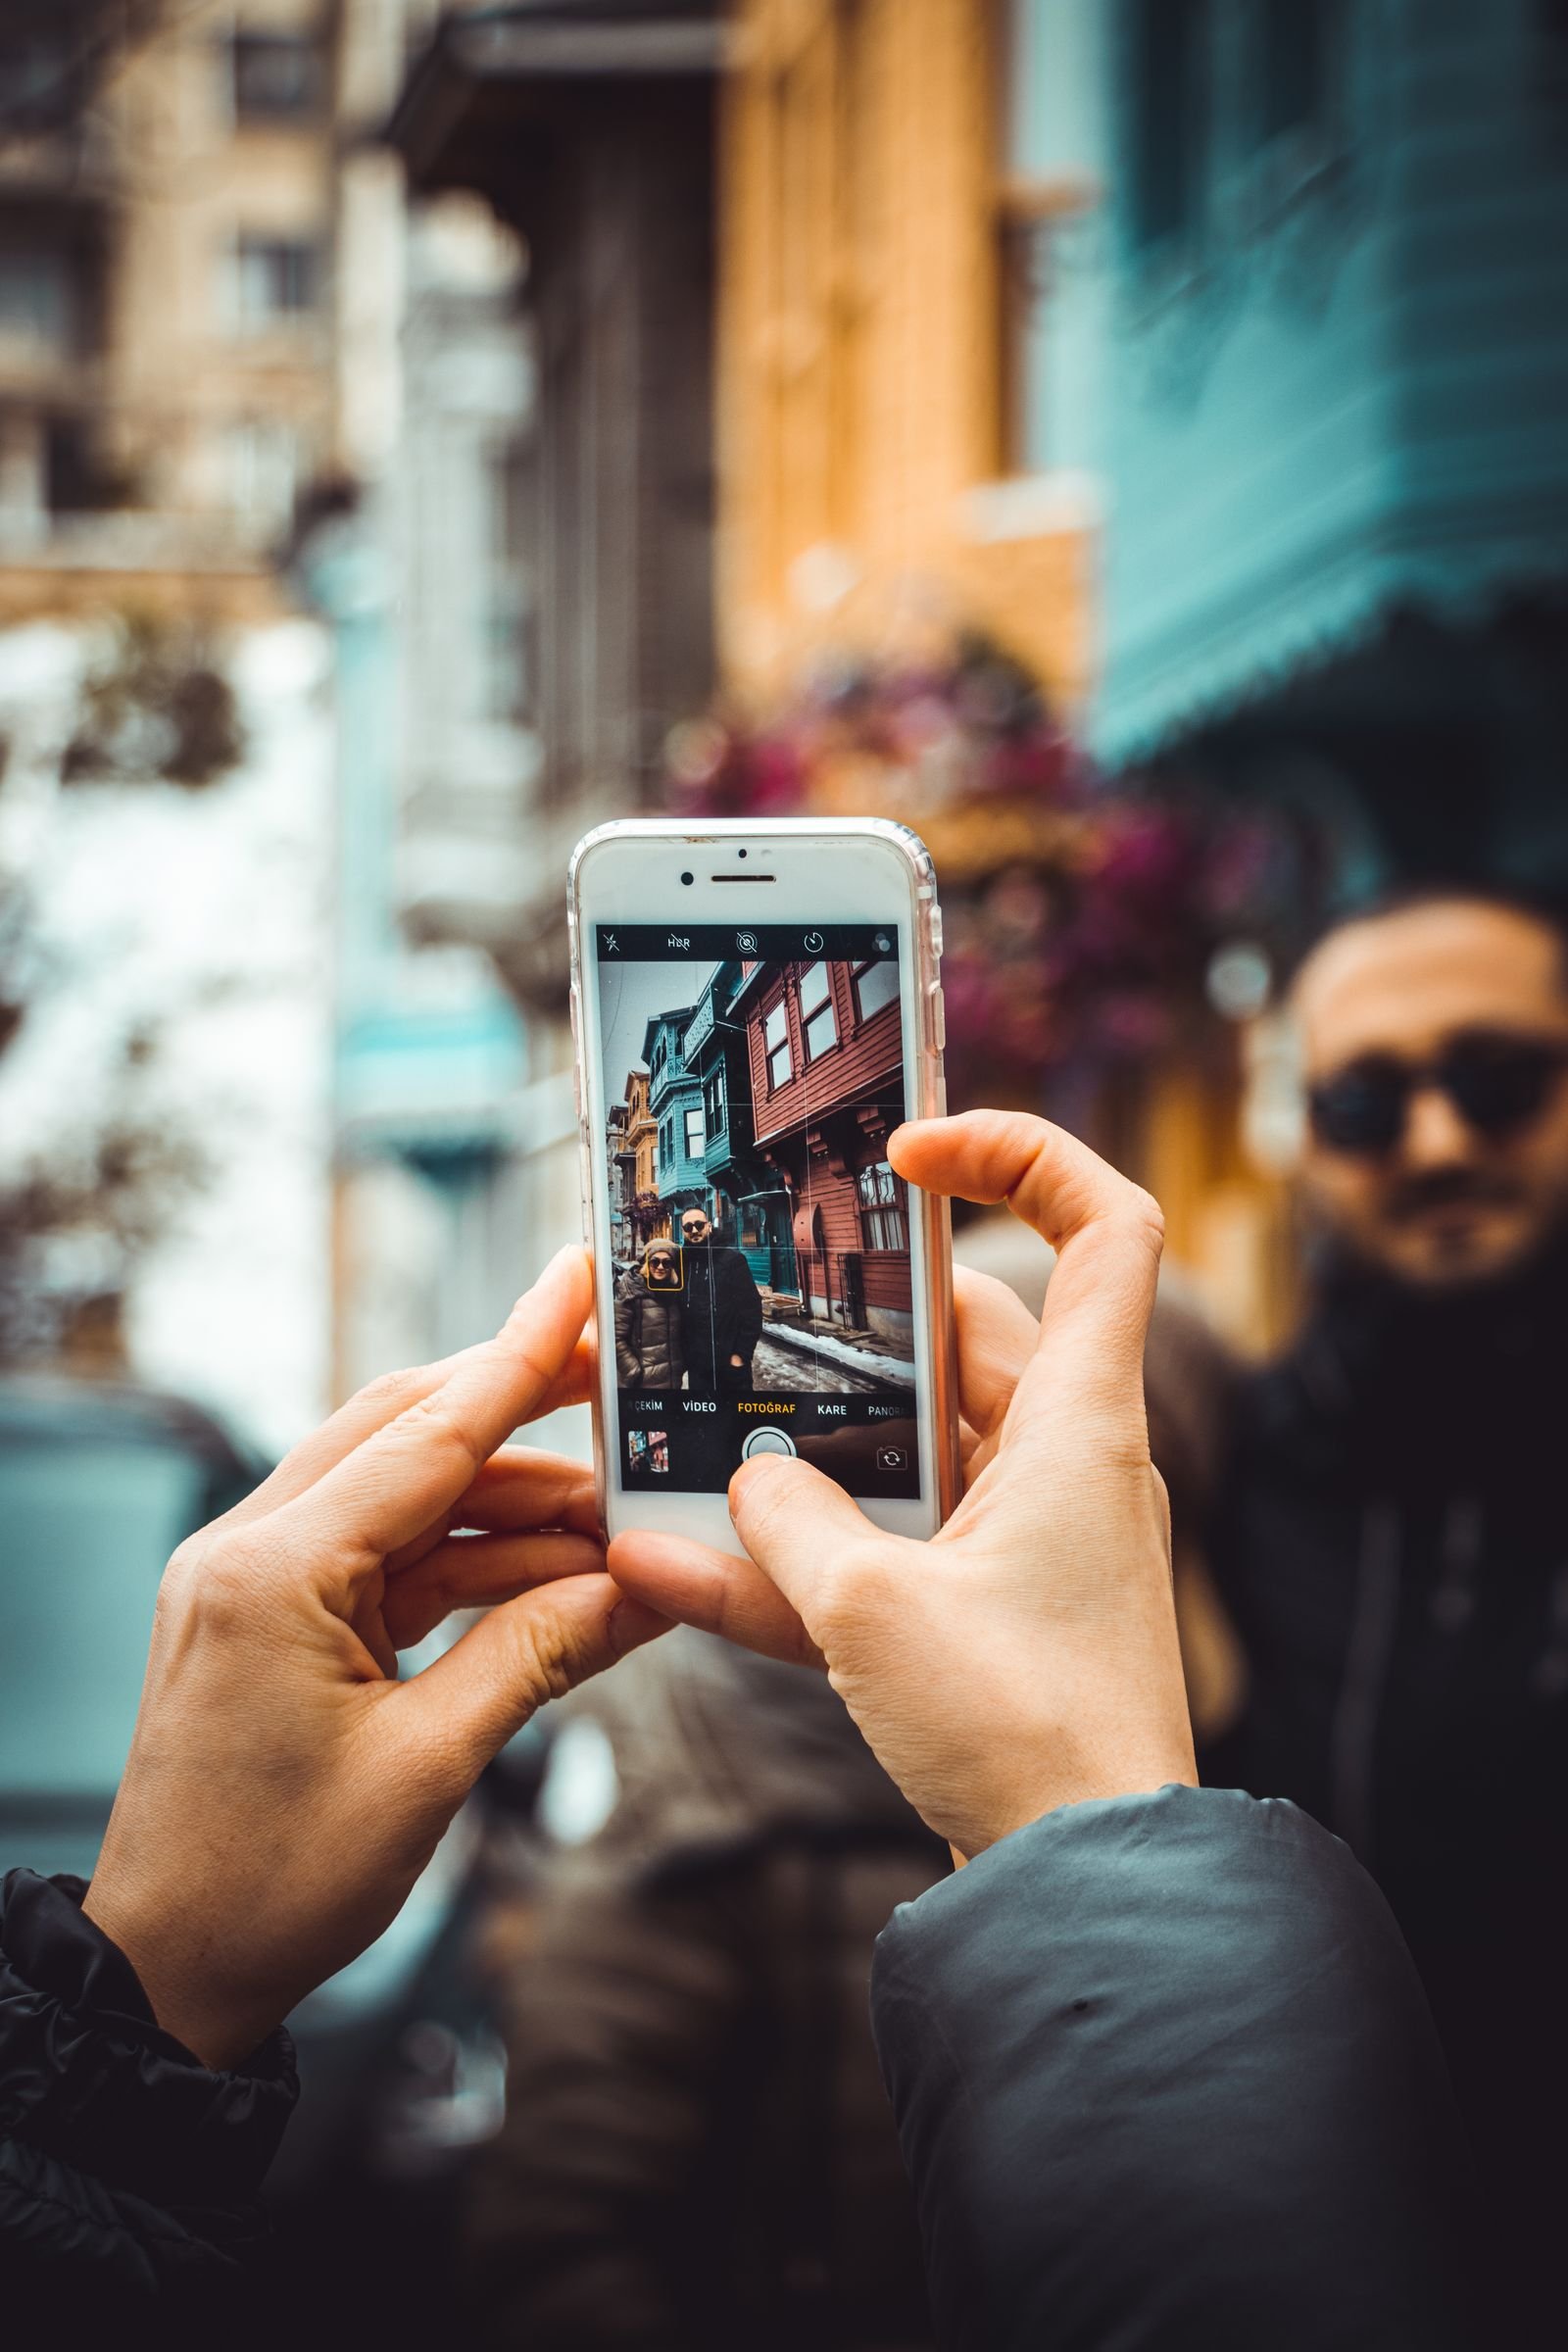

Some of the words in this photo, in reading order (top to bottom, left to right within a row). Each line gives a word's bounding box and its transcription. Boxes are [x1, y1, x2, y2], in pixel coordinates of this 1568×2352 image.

[667, 938, 691, 948] HDR
[682, 1399, 717, 1412] VİDEO
[738, 1401, 796, 1414] FOTOĞRAF
[817, 1404, 848, 1415] KARE
